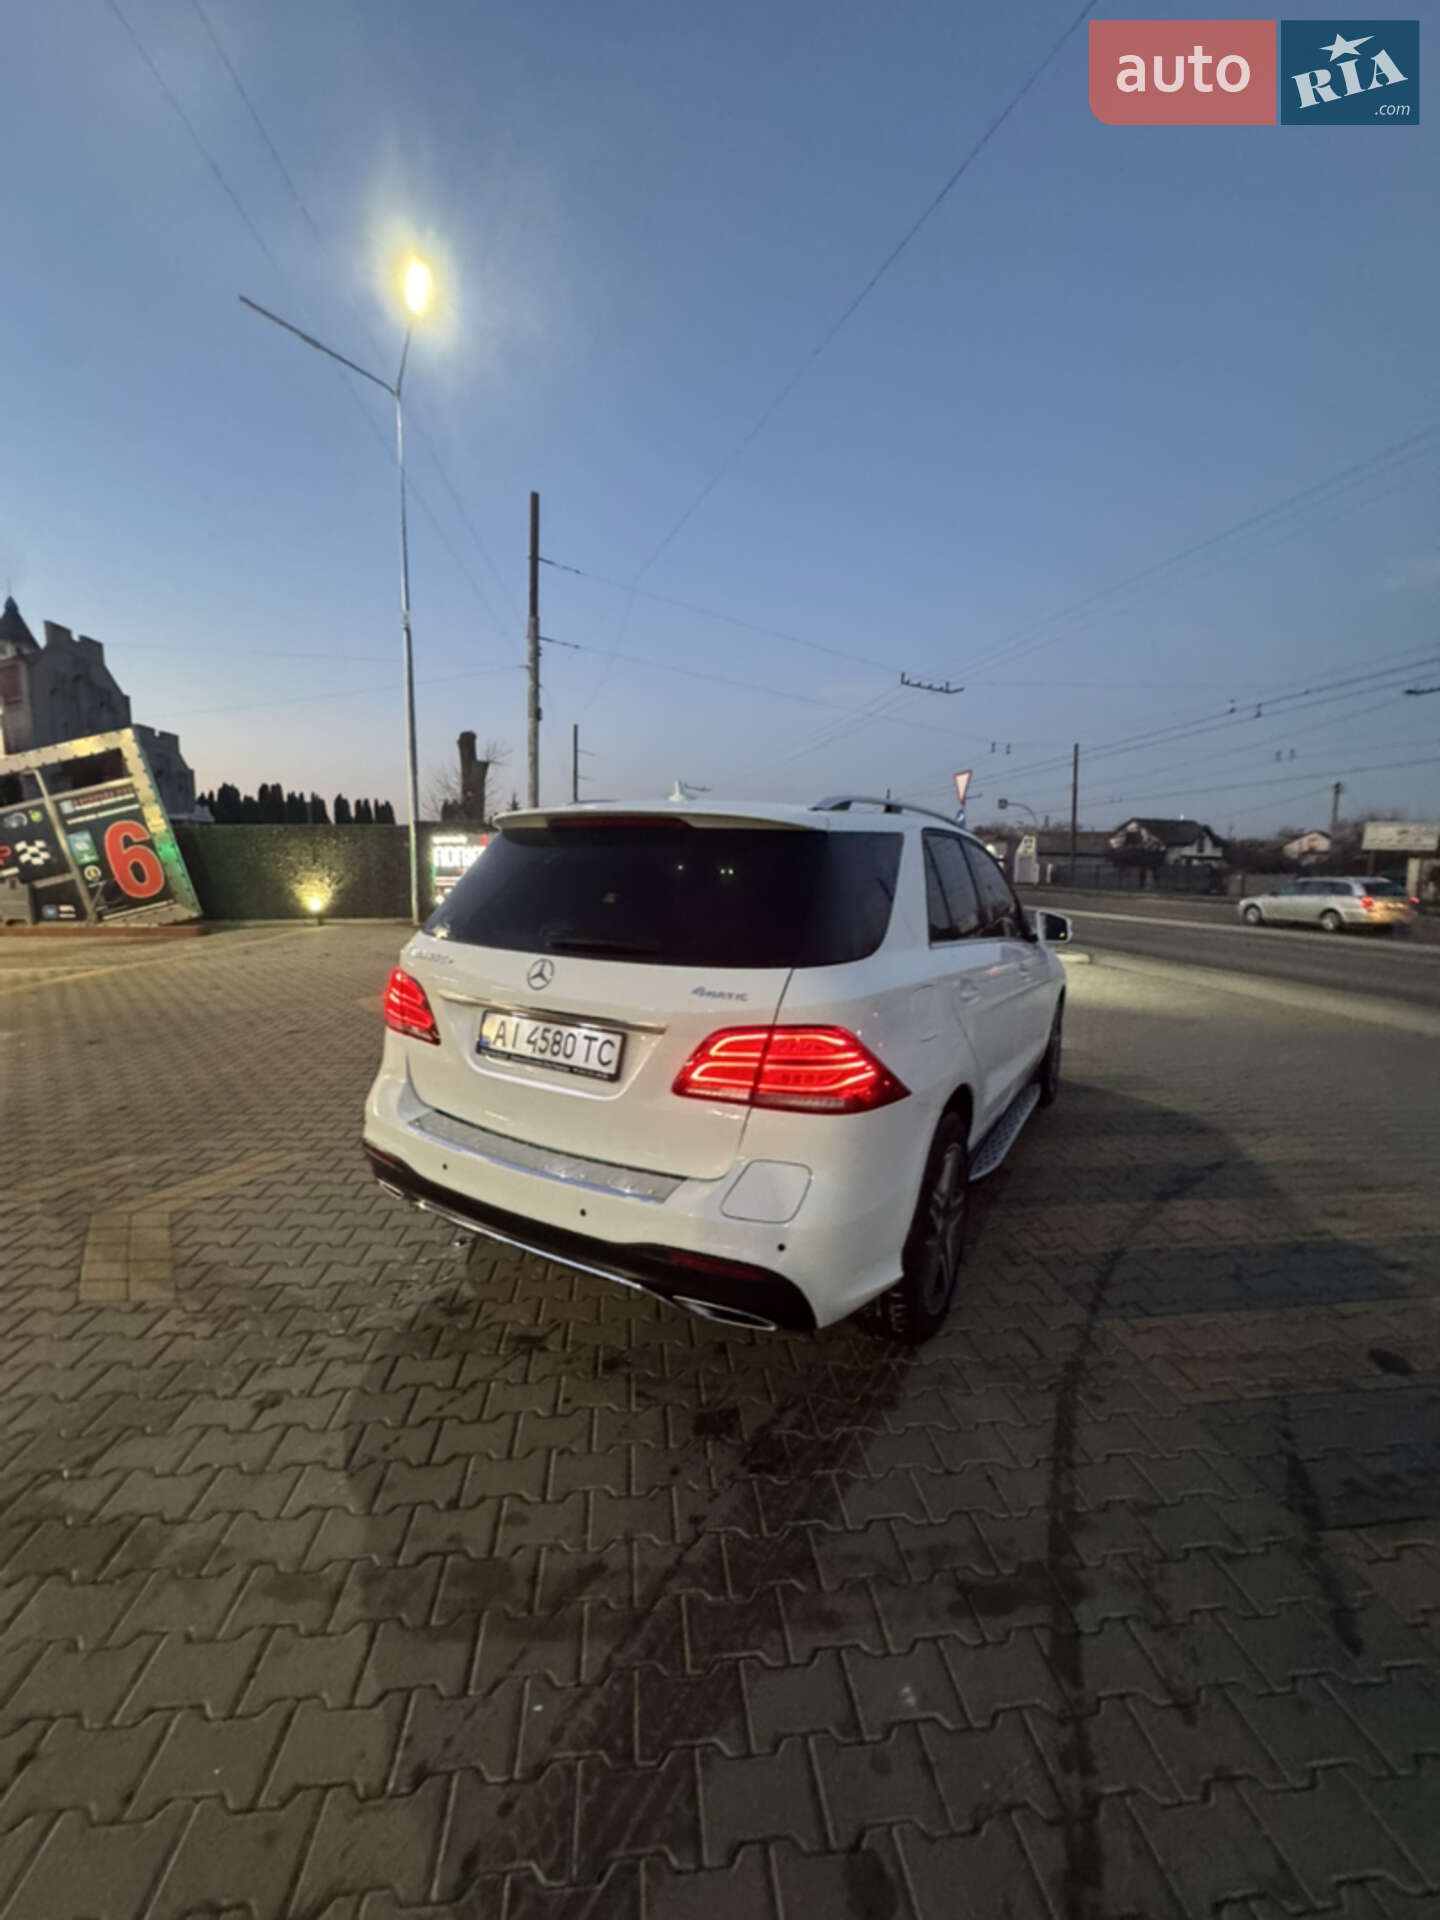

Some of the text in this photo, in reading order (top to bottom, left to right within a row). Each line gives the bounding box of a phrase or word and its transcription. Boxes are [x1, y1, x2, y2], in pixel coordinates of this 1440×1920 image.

[105, 820, 165, 898] 6
[493, 1020, 520, 1049] AI
[526, 1026, 577, 1059] 4580
[584, 1035, 615, 1066] TC
